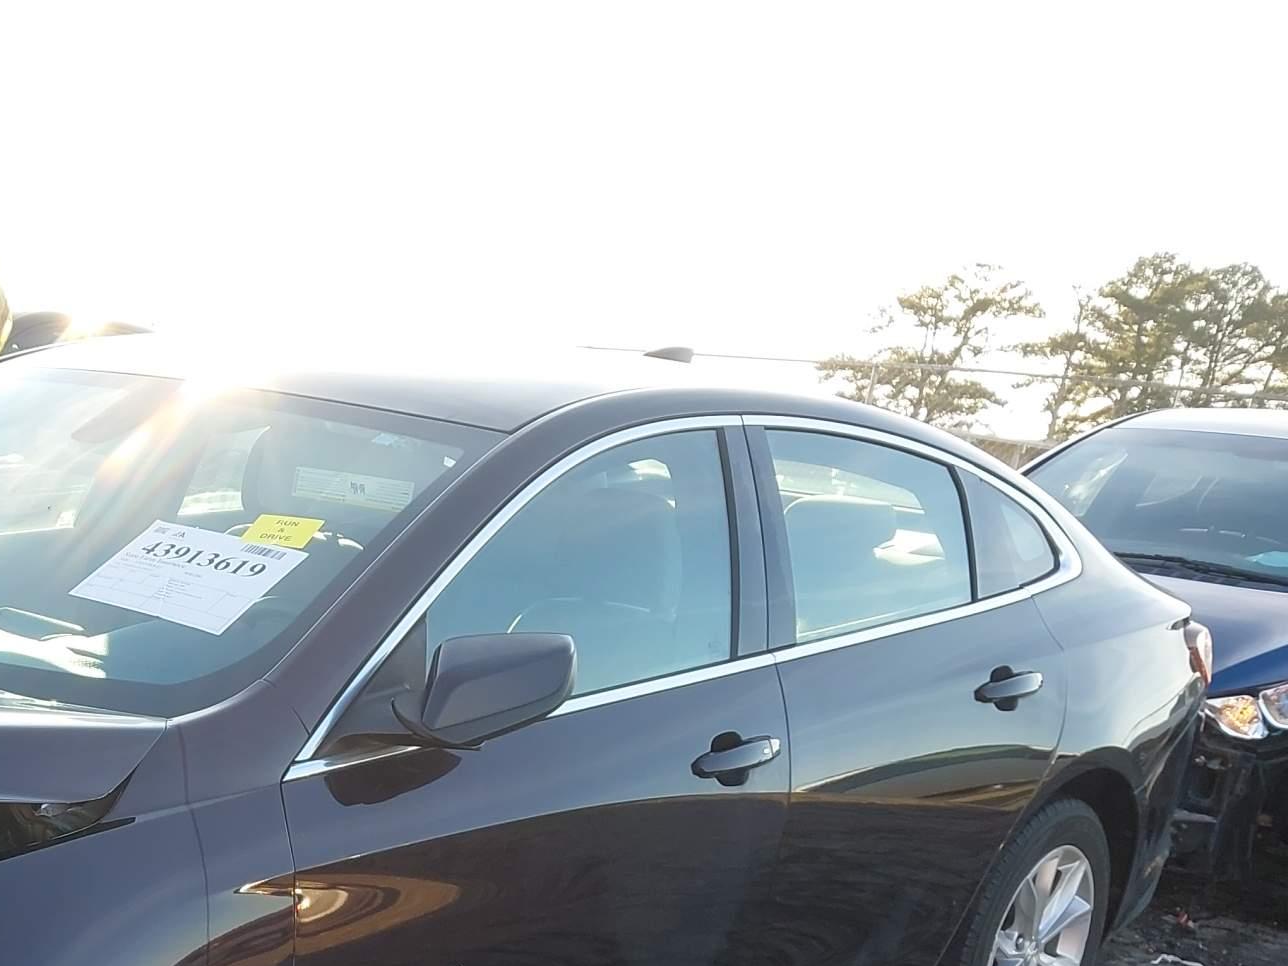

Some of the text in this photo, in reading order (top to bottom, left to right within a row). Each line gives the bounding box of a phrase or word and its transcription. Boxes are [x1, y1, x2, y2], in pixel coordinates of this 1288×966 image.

[276, 519, 300, 527] RUN
[259, 533, 293, 542] DRIVE
[142, 541, 267, 577] 43913619
